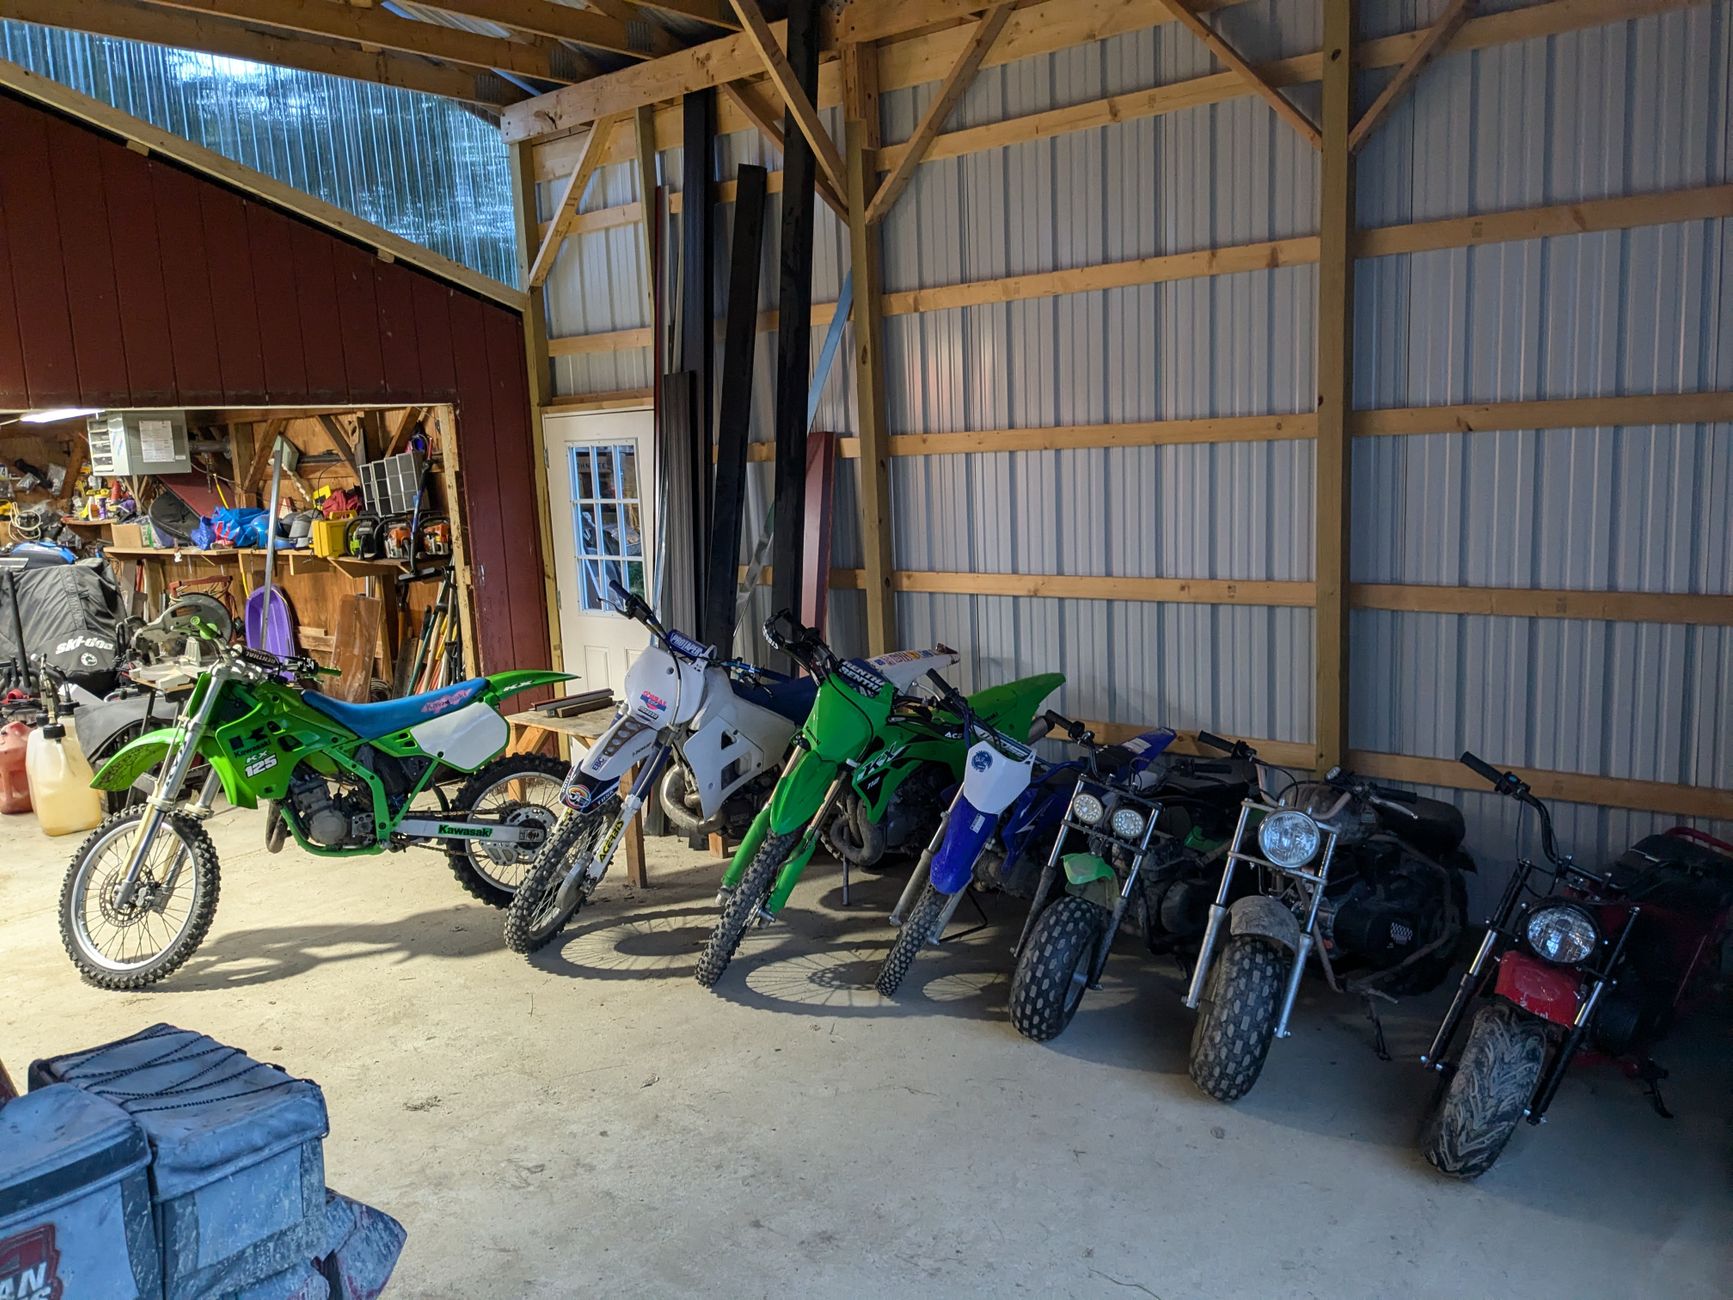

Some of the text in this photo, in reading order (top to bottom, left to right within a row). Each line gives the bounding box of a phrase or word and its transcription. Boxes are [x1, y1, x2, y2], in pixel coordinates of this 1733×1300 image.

[245, 753, 277, 777] 125
[438, 824, 493, 838] Kawasaki
[600, 821, 624, 863] ACERBIS
